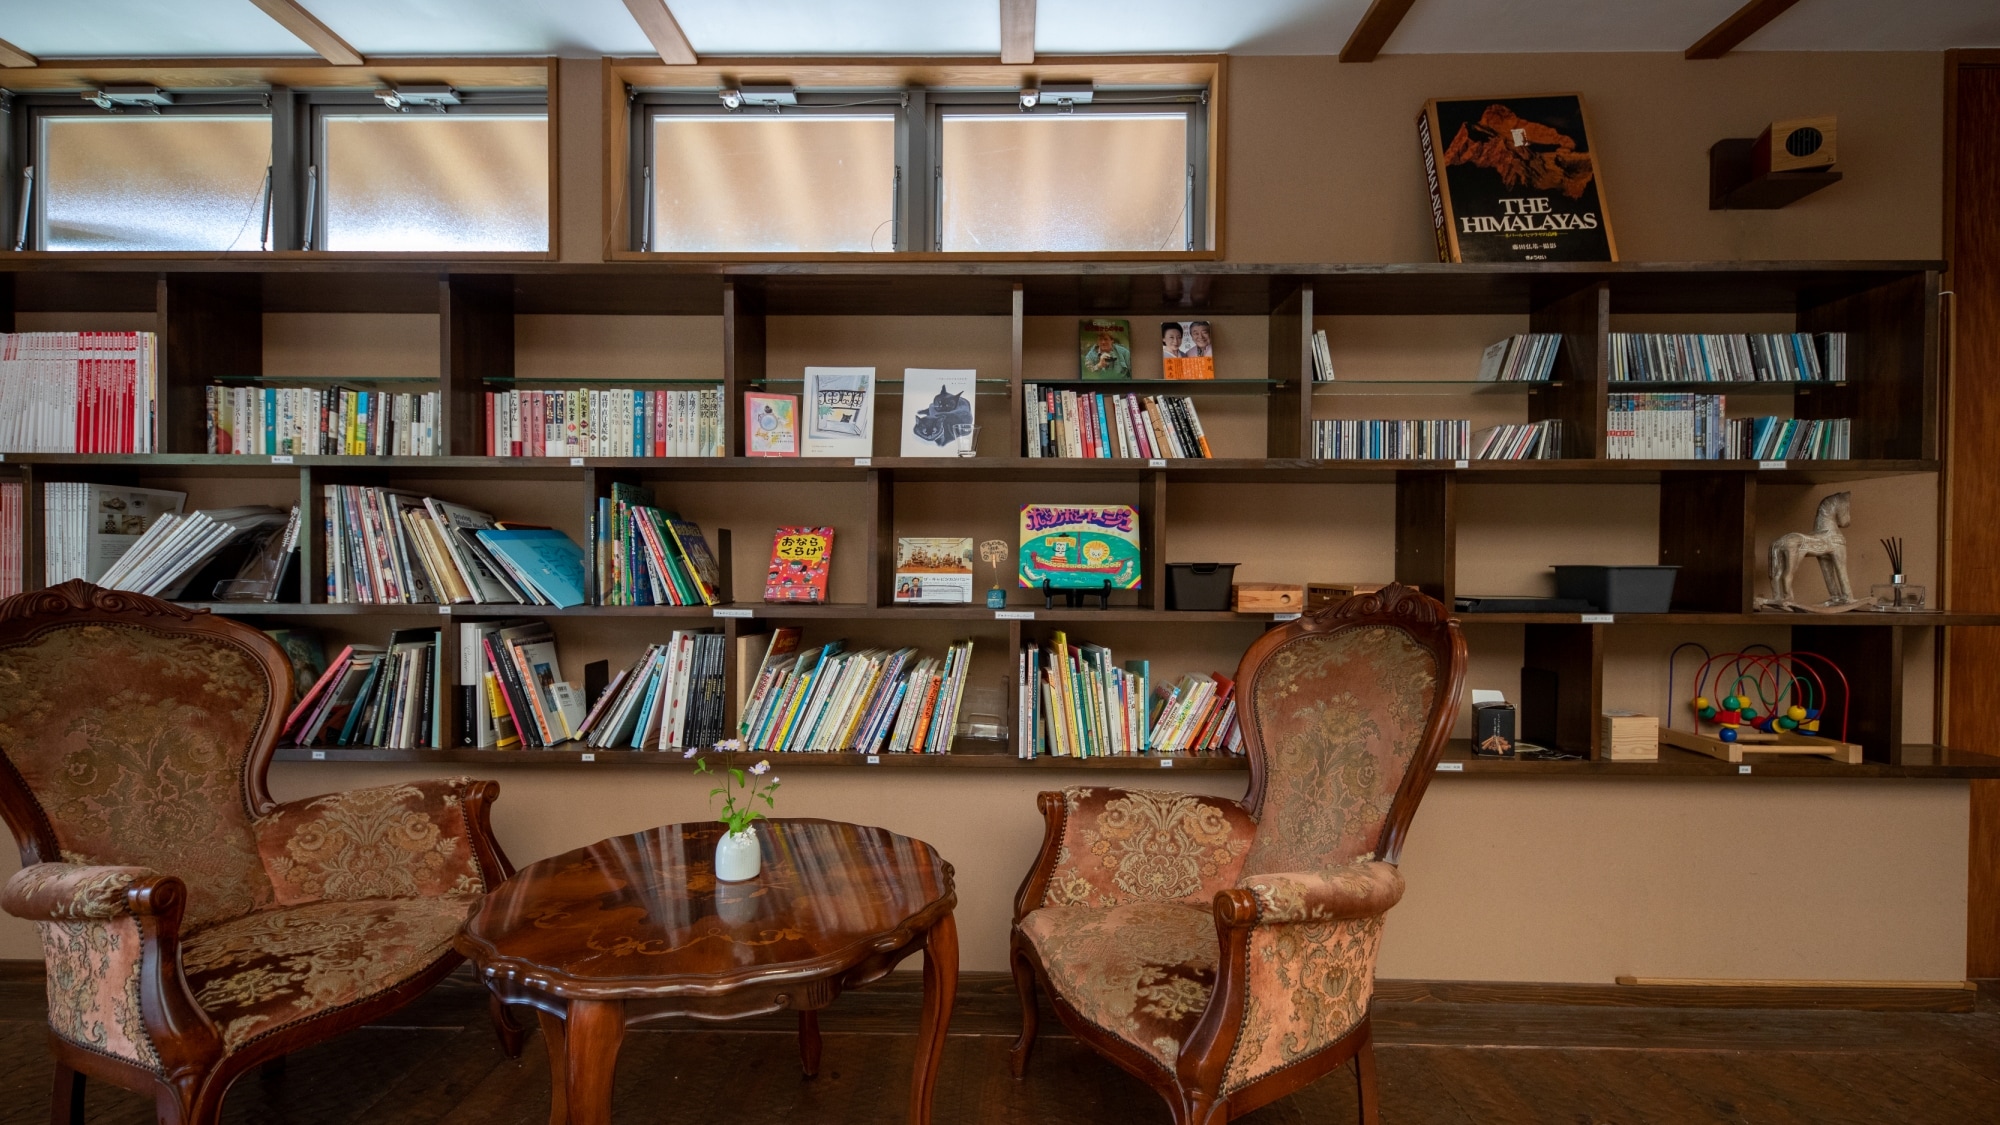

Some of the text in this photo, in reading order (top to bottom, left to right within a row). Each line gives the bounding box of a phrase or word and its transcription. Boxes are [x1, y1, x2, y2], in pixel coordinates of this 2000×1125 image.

[1420, 114, 1444, 229] THE HIMALAYAS
[1499, 198, 1552, 215] THE
[1460, 213, 1598, 233] HIMALAYAS
[781, 537, 818, 547] おなら
[781, 546, 823, 556] くらげ
